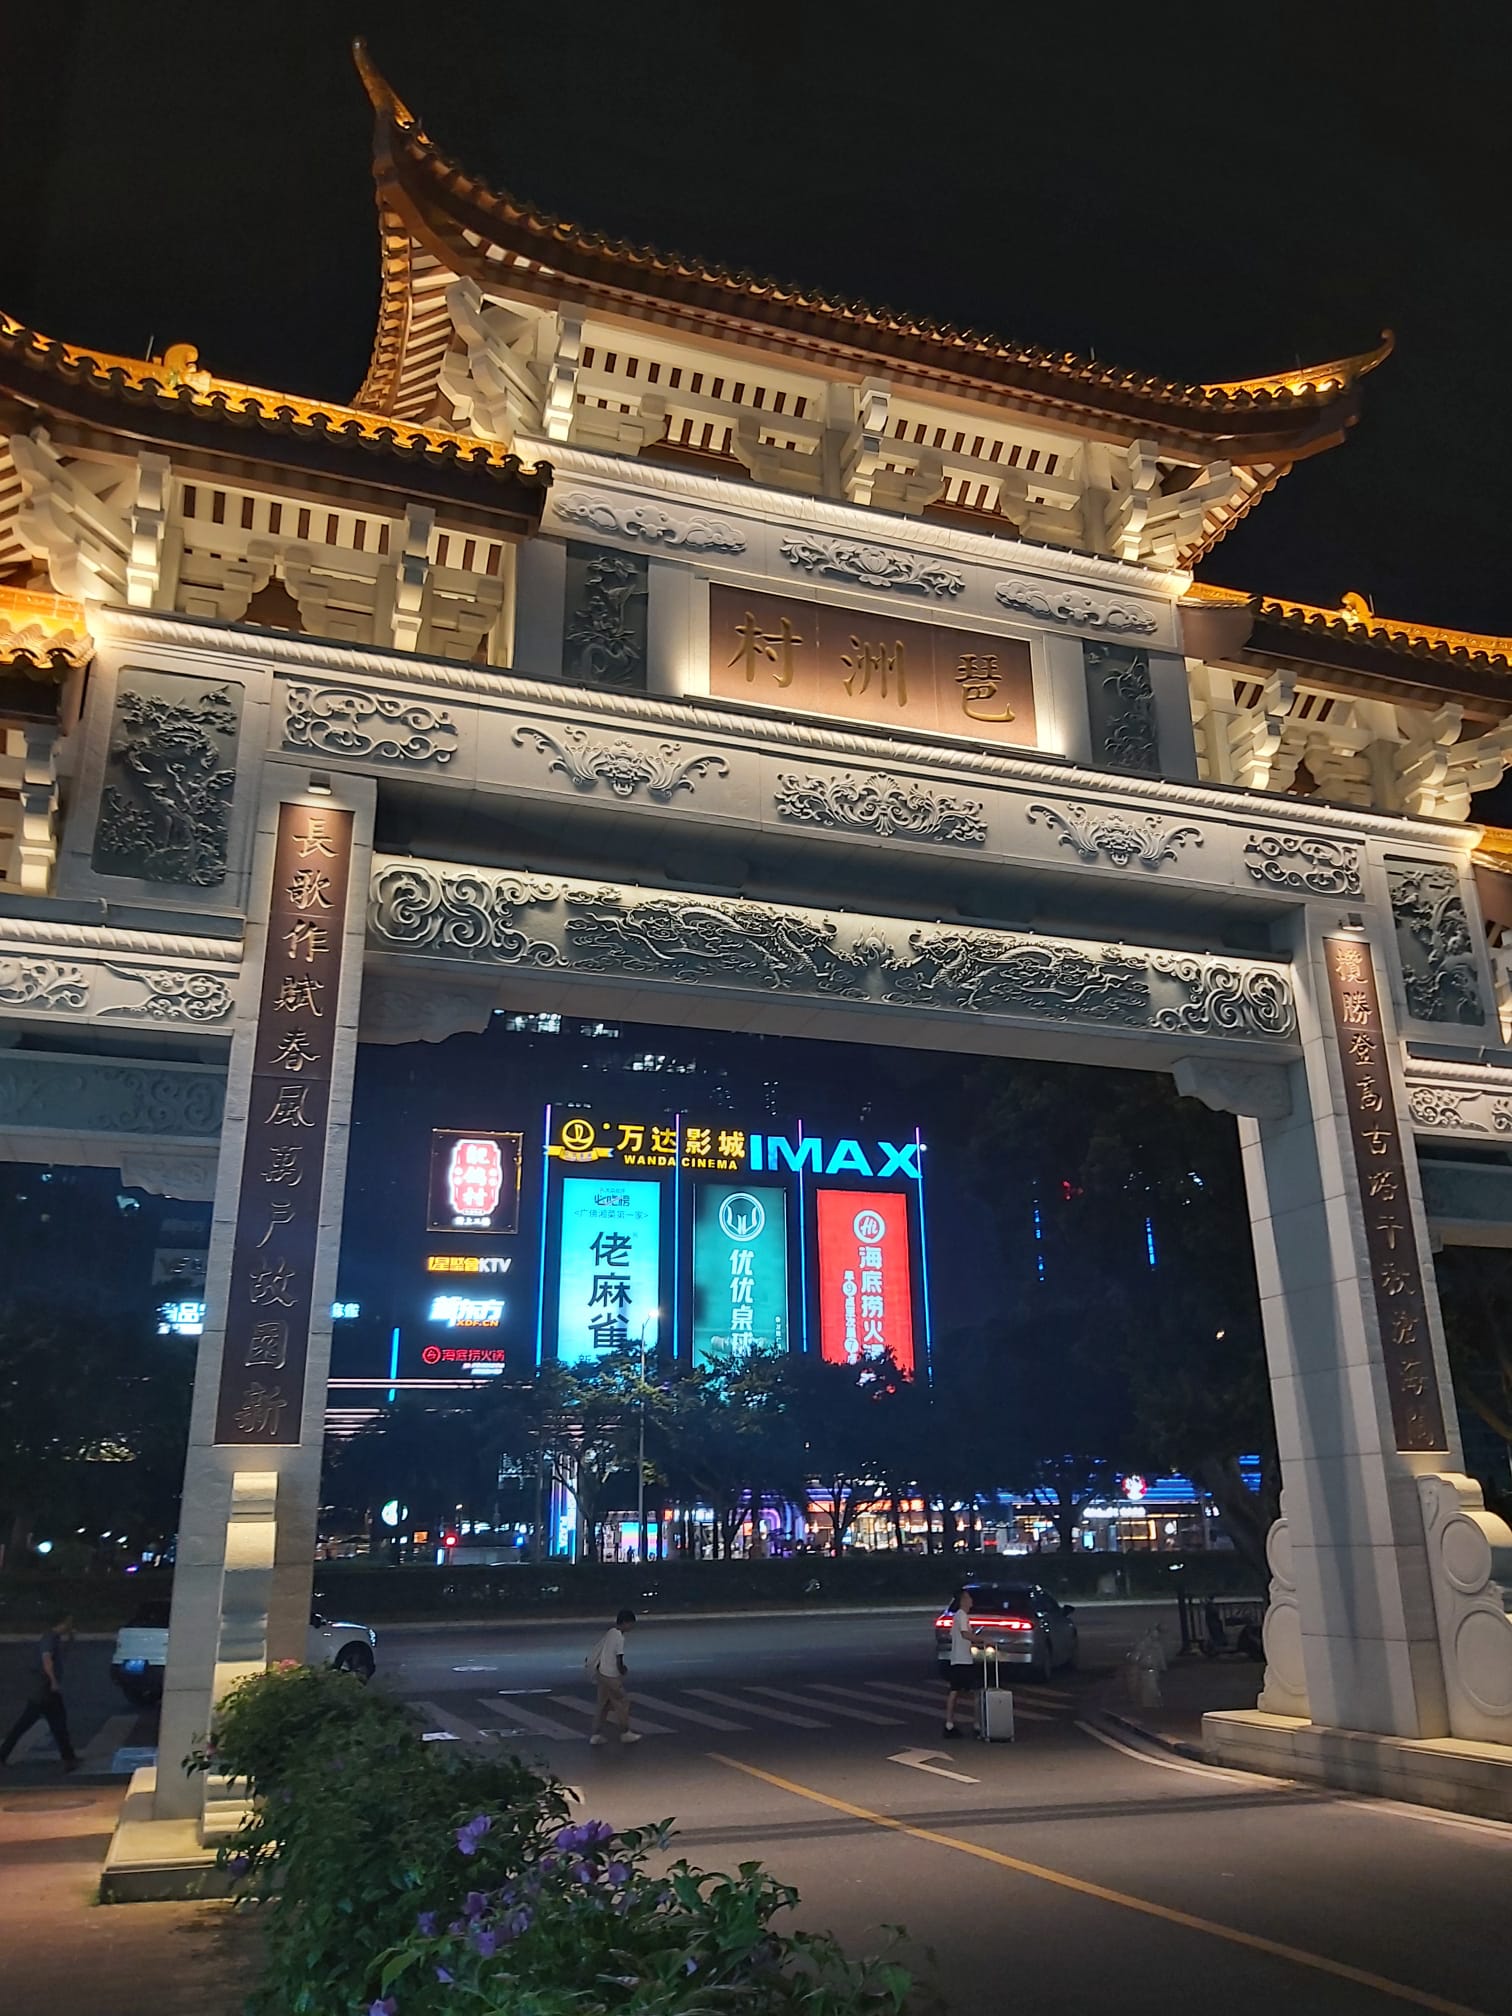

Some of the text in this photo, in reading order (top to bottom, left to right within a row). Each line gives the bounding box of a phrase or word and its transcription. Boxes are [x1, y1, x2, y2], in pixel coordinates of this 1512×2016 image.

[617, 1124, 745, 1158] 万达影城
[750, 1134, 923, 1179] IMAX
[624, 1154, 738, 1170] WANDA CINEMA
[587, 1231, 632, 1349] 佬麻雀
[729, 1249, 755, 1357] 优优桌球
[442, 1349, 505, 1362] 海底捞火锅
